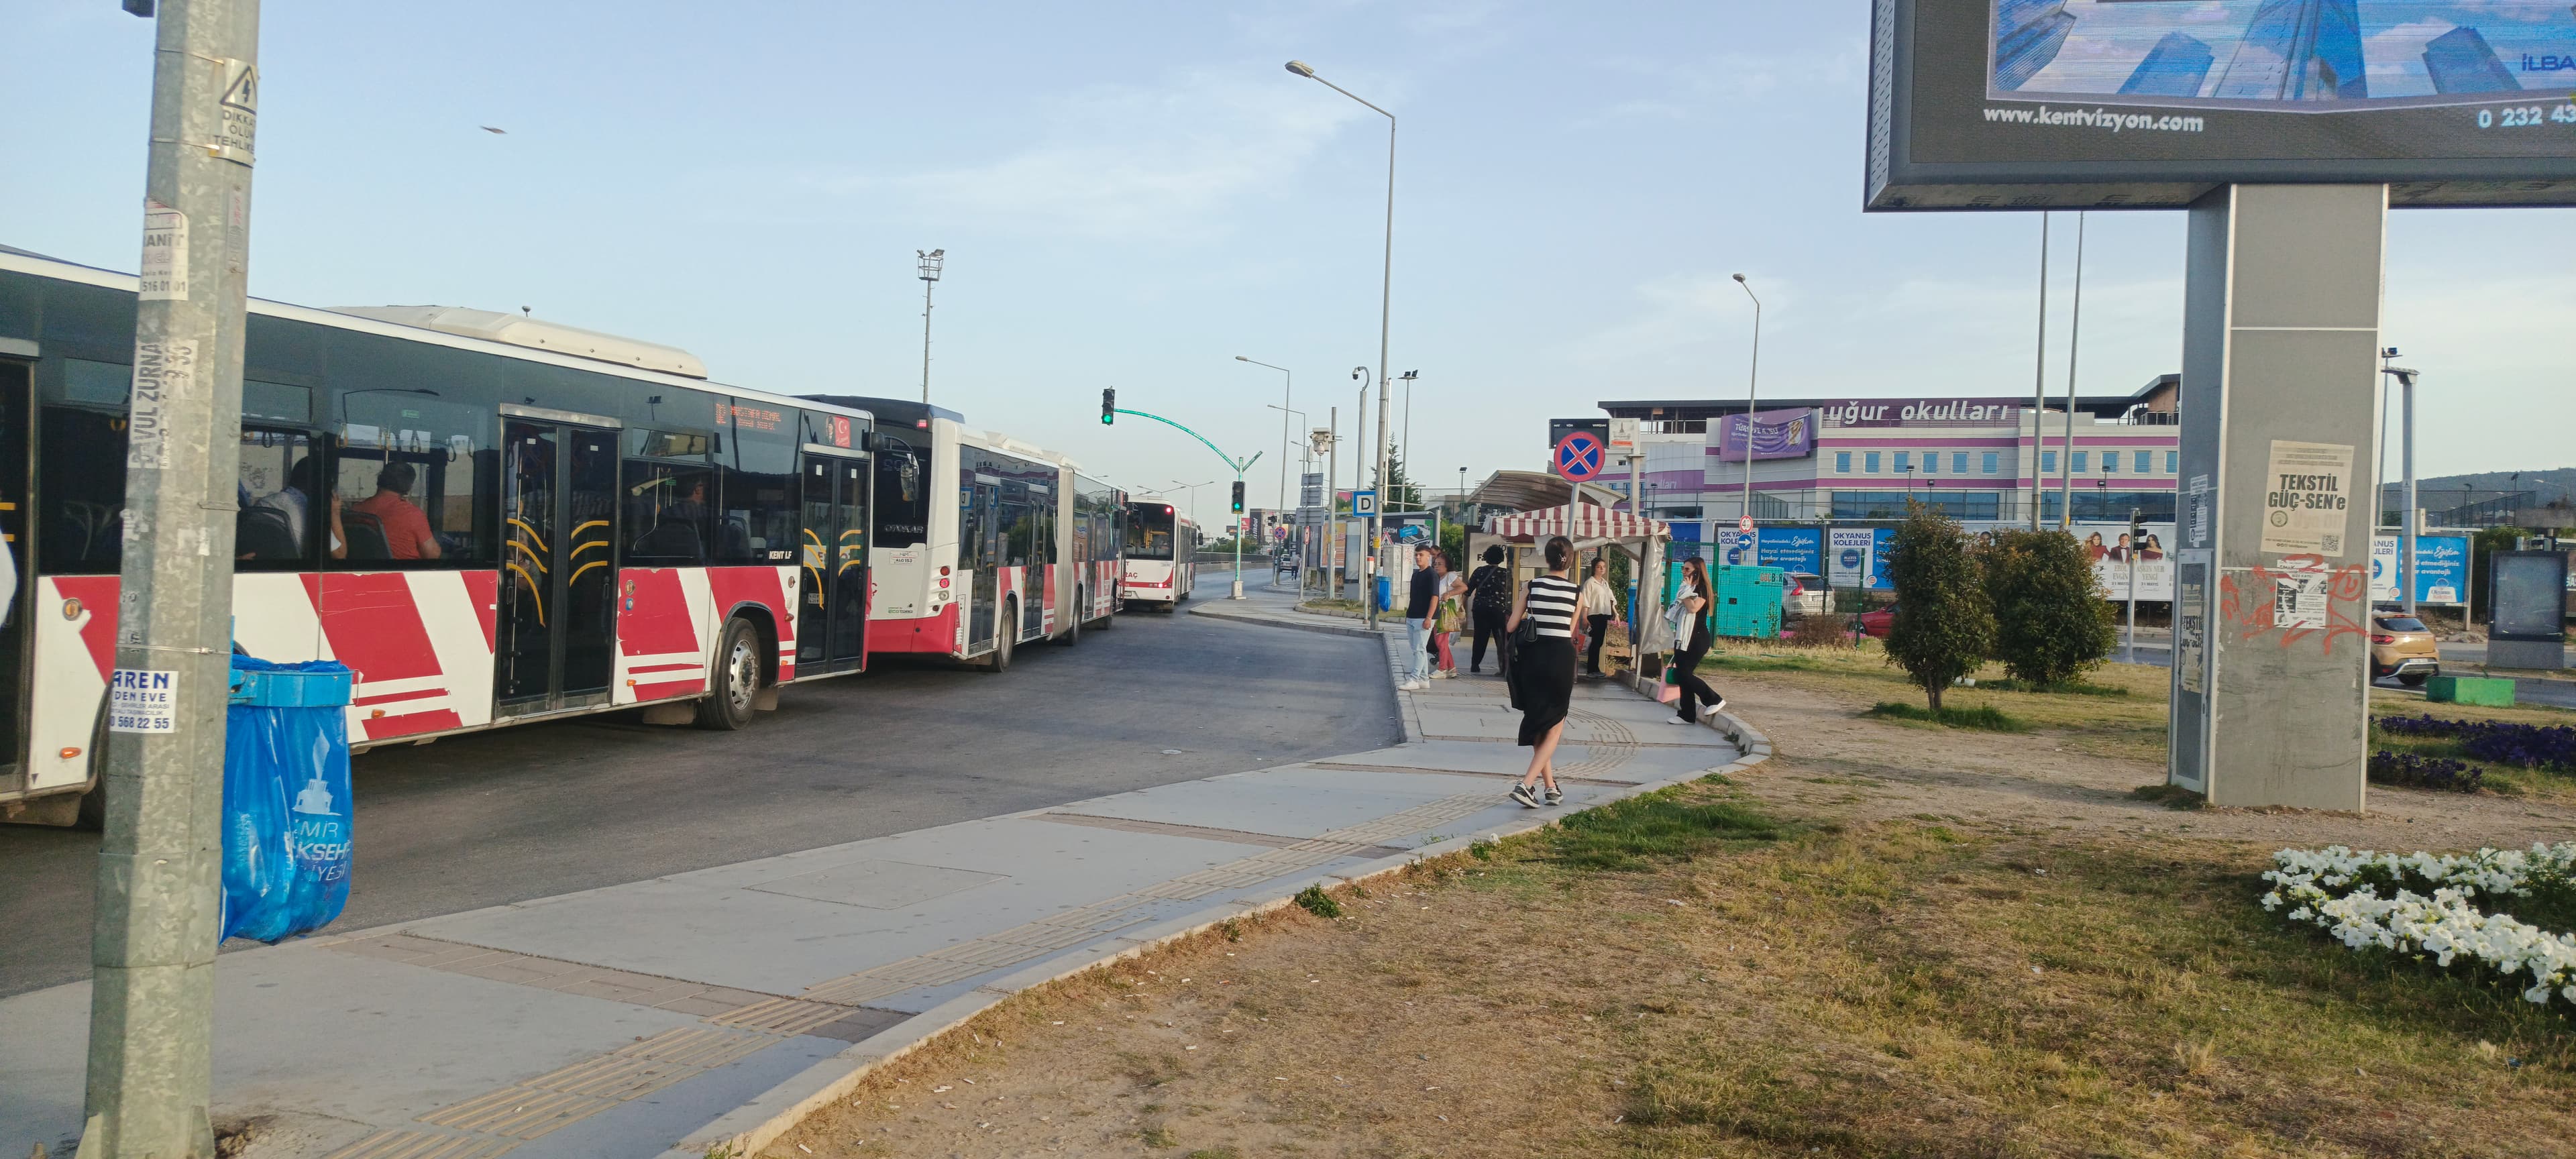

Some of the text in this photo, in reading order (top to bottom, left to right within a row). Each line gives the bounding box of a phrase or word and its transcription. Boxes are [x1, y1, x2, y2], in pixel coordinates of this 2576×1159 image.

[1984, 106, 2204, 133] www.kentvizyon.com
[2478, 104, 2576, 128] 0 232 43
[136, 343, 163, 402] ZURNA
[1829, 400, 2008, 425] uğur okulları
[2279, 473, 2338, 492] TEKSTİL
[1361, 498, 1371, 510] D
[2268, 490, 2346, 511] GÜÇ-SEN'e
[769, 551, 792, 559] KENT LF
[115, 691, 166, 702] DEN EVE
[118, 716, 135, 728] 568
[137, 717, 150, 728] 22
[154, 718, 170, 728] 55
